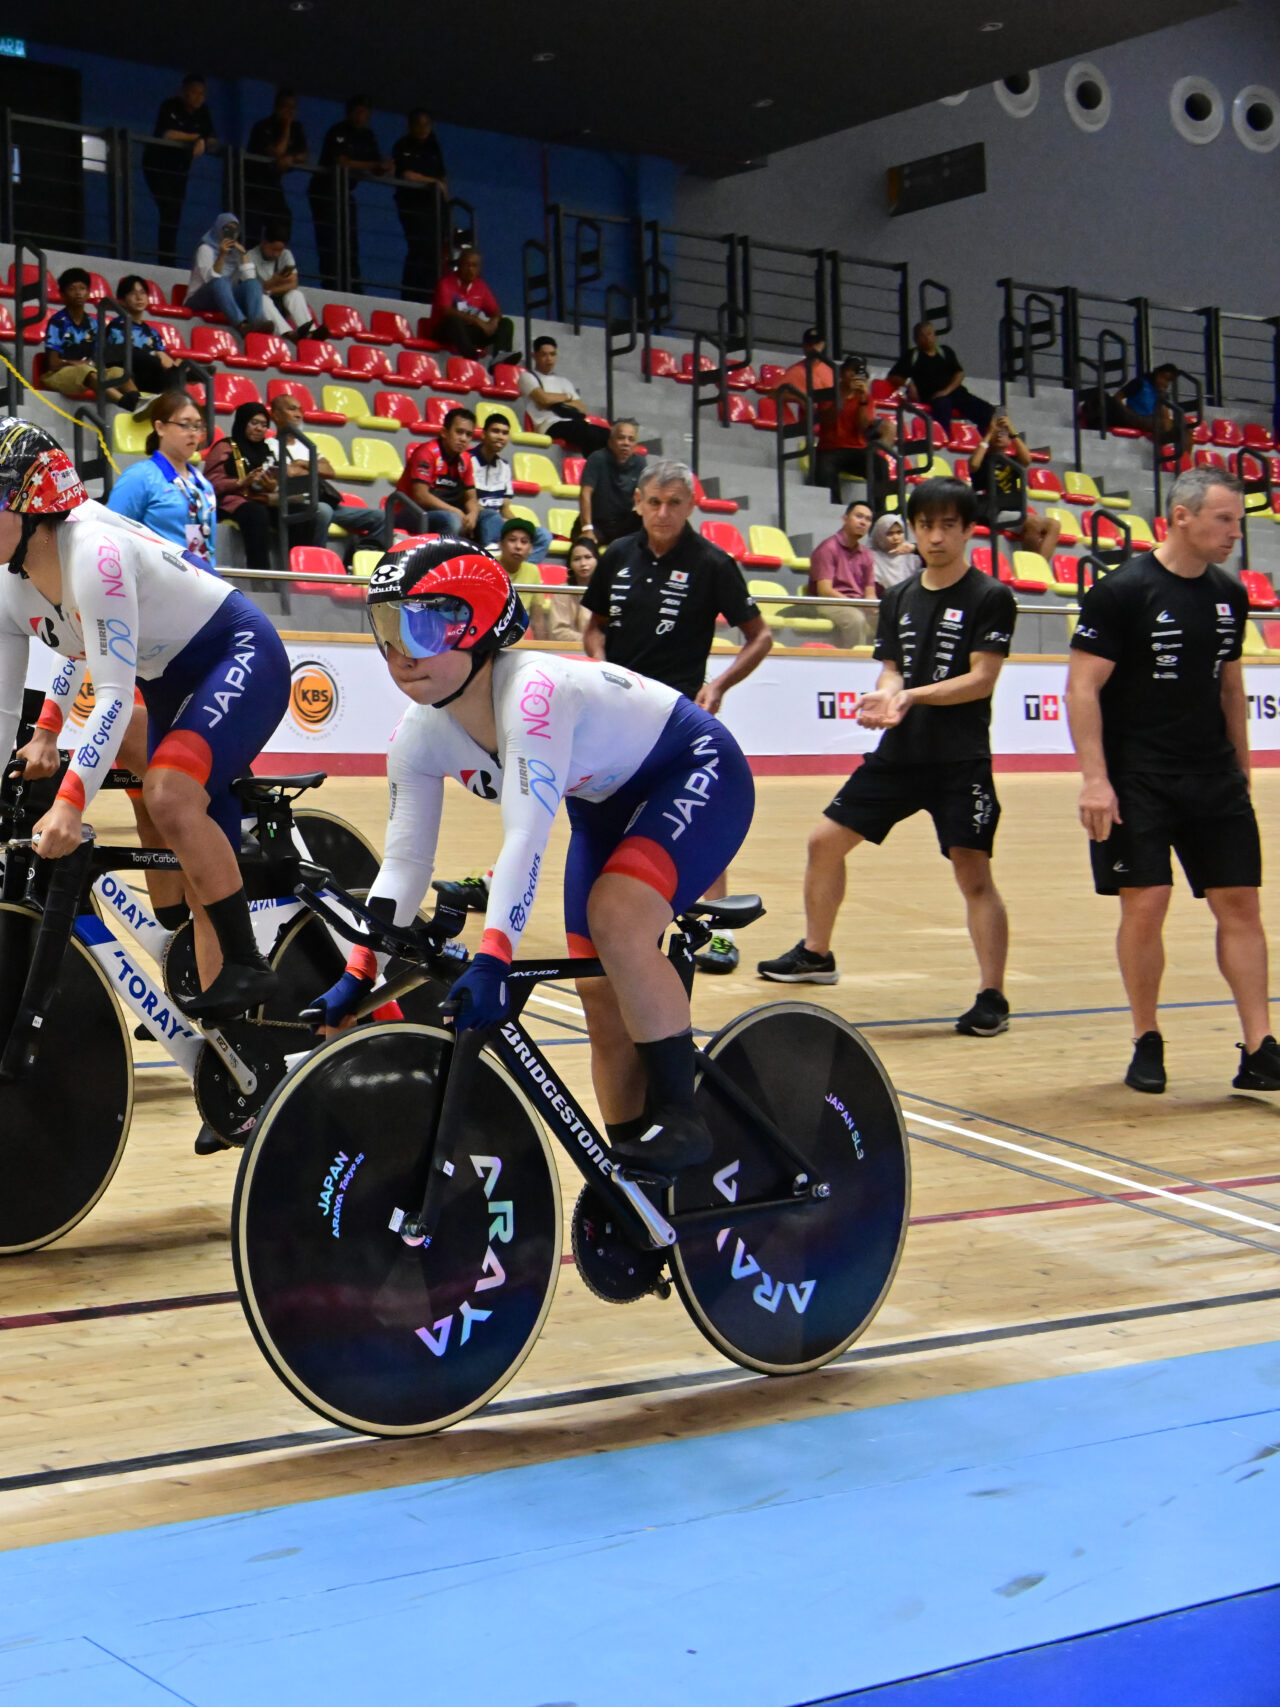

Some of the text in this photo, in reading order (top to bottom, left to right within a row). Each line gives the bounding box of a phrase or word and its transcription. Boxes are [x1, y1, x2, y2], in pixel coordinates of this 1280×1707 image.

[97, 619, 107, 656] KEIRIN
[202, 630, 256, 728] JAPAN
[301, 689, 329, 705] KBS
[93, 698, 123, 746] Cyclers
[113, 774, 129, 784] Toray
[517, 757, 529, 796] KEIRIN
[662, 735, 719, 841] JAPAN
[131, 852, 152, 865] Toray
[524, 852, 541, 907] Cyclers
[508, 969, 559, 978] ANCHOR
[500, 1022, 614, 1176] BRIDGESTONE
[825, 1093, 854, 1130] JAPAN
[318, 1150, 349, 1216] JAPAN
[332, 1193, 344, 1239] ARAYA
[339, 1163, 356, 1191] Tokyo
[414, 1155, 514, 1357] ARAYA
